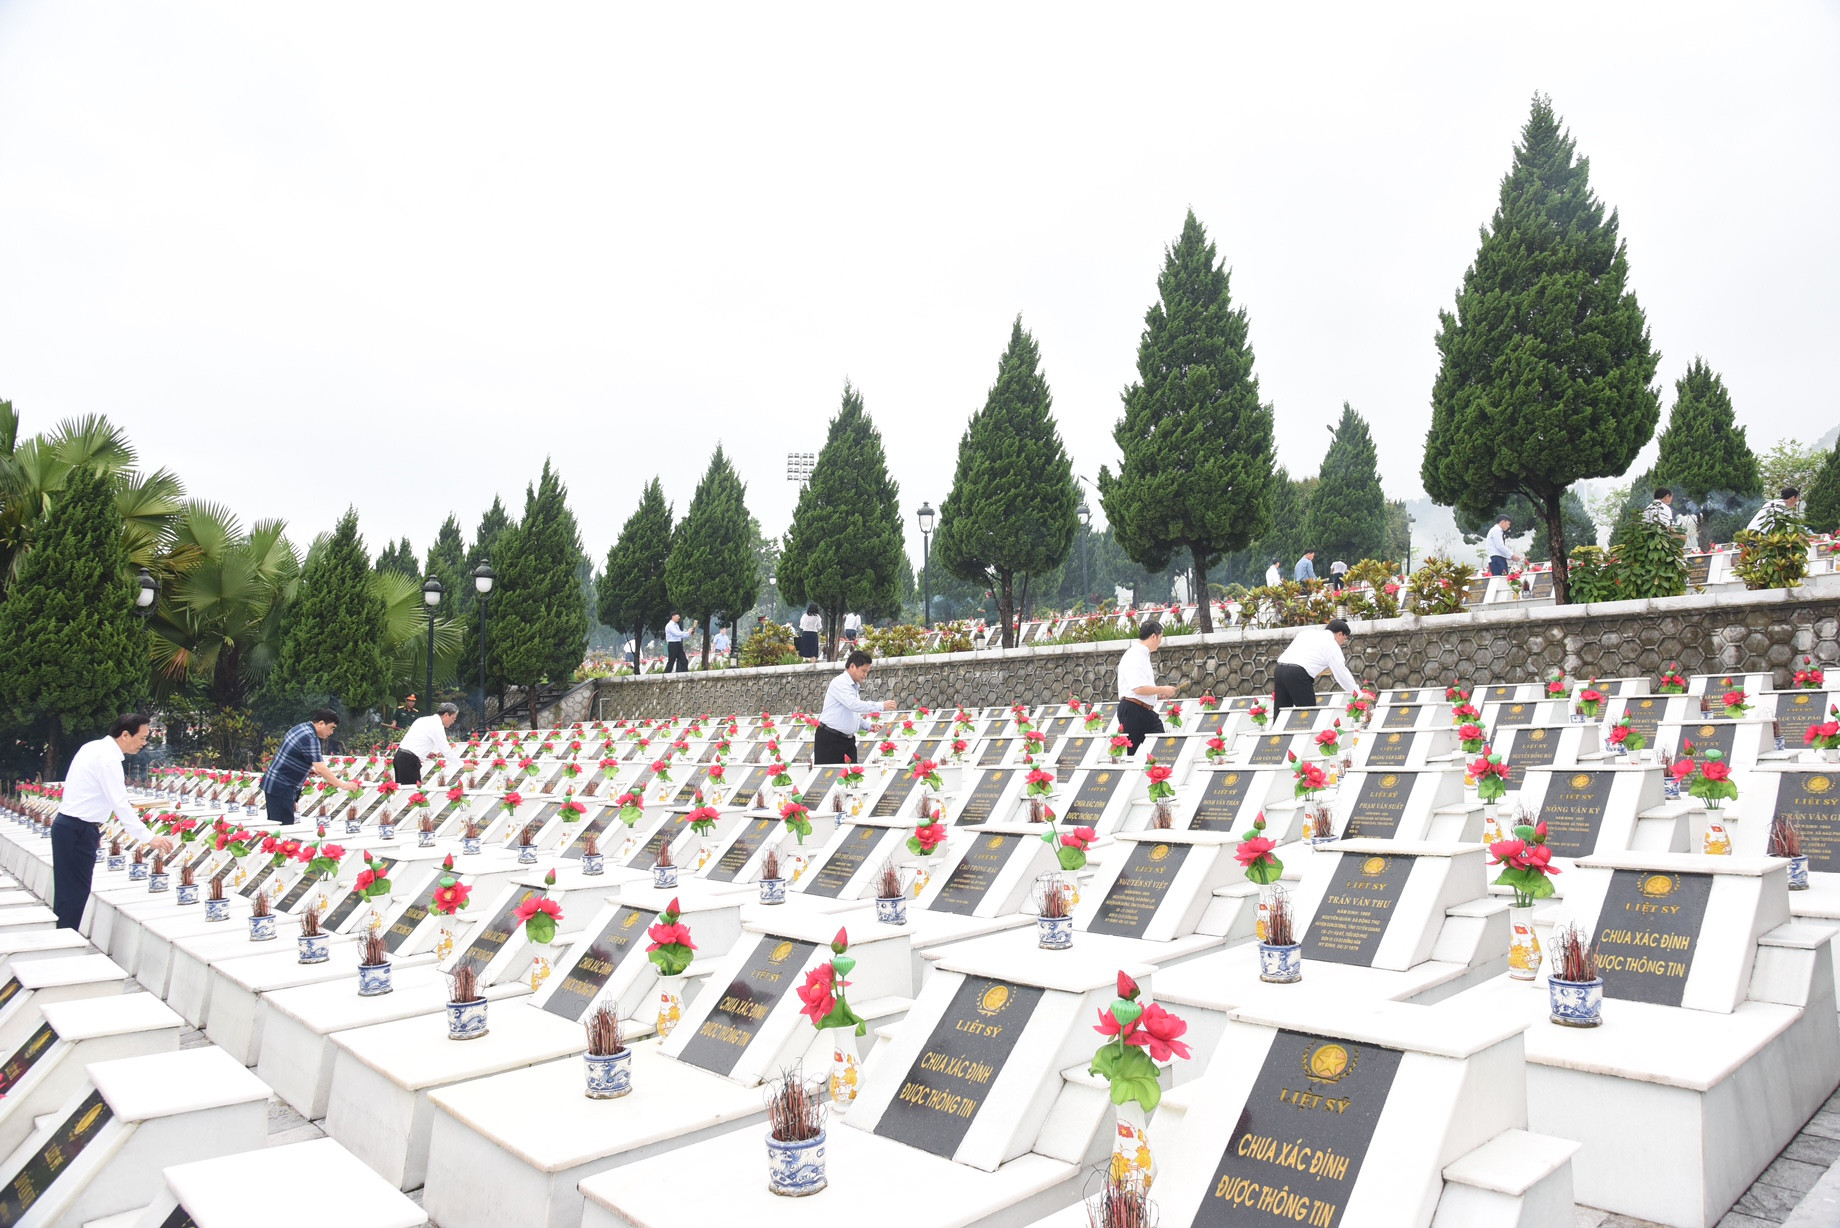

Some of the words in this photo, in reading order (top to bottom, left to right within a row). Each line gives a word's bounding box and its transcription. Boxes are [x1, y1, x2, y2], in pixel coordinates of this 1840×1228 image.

[1352, 896, 1370, 907] VĂN
[1626, 902, 1658, 914] LIỆT
[1601, 929, 1632, 944] CHƯA
[1633, 929, 1660, 947] XÁC
[1660, 932, 1690, 952] ĐỊNH
[1625, 956, 1666, 975] THÔNG
[1667, 962, 1686, 977] TIN
[955, 1019, 985, 1036] LIỆT
[984, 1025, 1003, 1038] SỸ
[921, 1051, 948, 1072] CHƯA
[944, 1054, 970, 1078] XÁC
[965, 1060, 994, 1084] ĐỊNH
[900, 1082, 930, 1106] ĐƯỢC
[926, 1088, 961, 1114] THÔNG
[956, 1098, 977, 1118] TIN
[1280, 1088, 1323, 1112] LIỆT
[1323, 1096, 1352, 1114] SỸ
[1238, 1133, 1278, 1163] CHƯA
[1275, 1138, 1311, 1170] XÁC
[1309, 1148, 1350, 1181] ĐỊNH
[1215, 1175, 1259, 1208] ĐƯỢC
[1256, 1186, 1310, 1221] THÔNG
[1308, 1200, 1336, 1228] TIN
